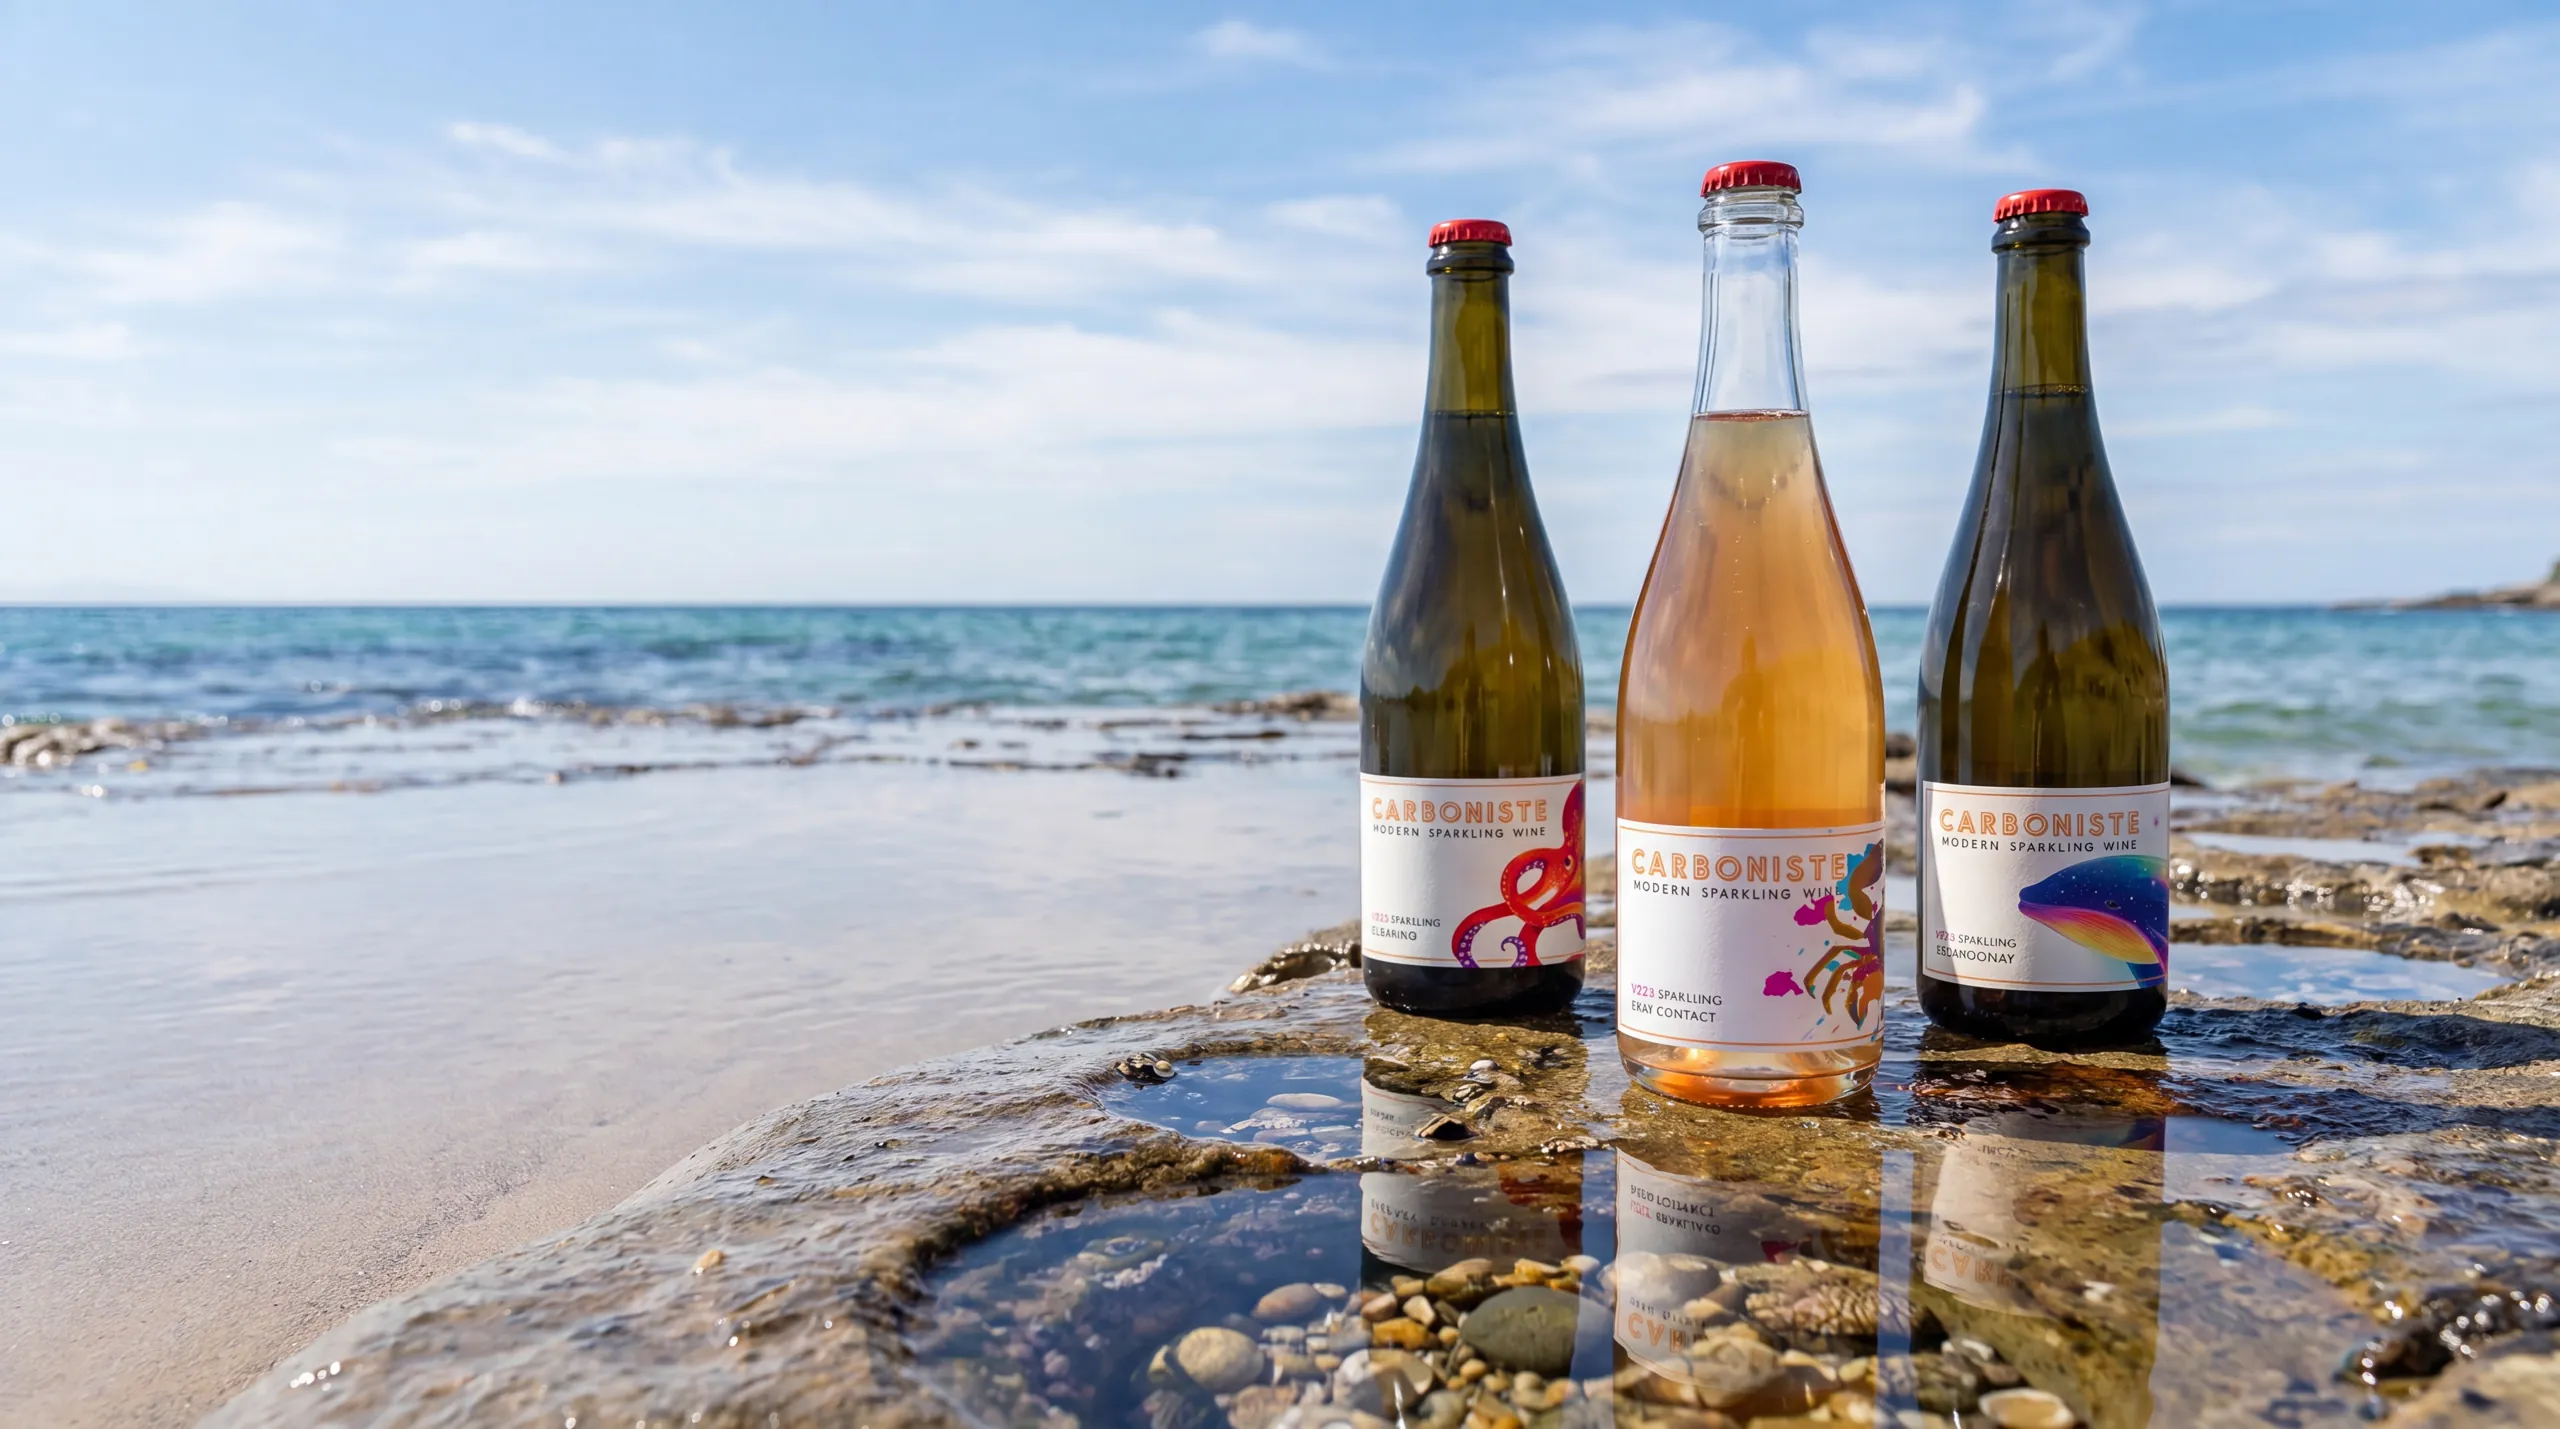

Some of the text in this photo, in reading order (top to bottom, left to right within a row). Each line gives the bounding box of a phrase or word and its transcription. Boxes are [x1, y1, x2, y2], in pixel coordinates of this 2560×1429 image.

[1372, 797, 1547, 823] CARBONISTE
[1373, 824, 1546, 839] MODERN SPARKLING WINE
[1939, 809, 2140, 837] CARBONISTE
[1942, 836, 2137, 853] MODERN SPARKLING WINE
[1631, 848, 1846, 883] CARBONISTE
[1633, 879, 1691, 897] MODERN
[1701, 887, 1792, 900] SPARKLING
[1656, 1006, 1717, 1023] CONTACT
